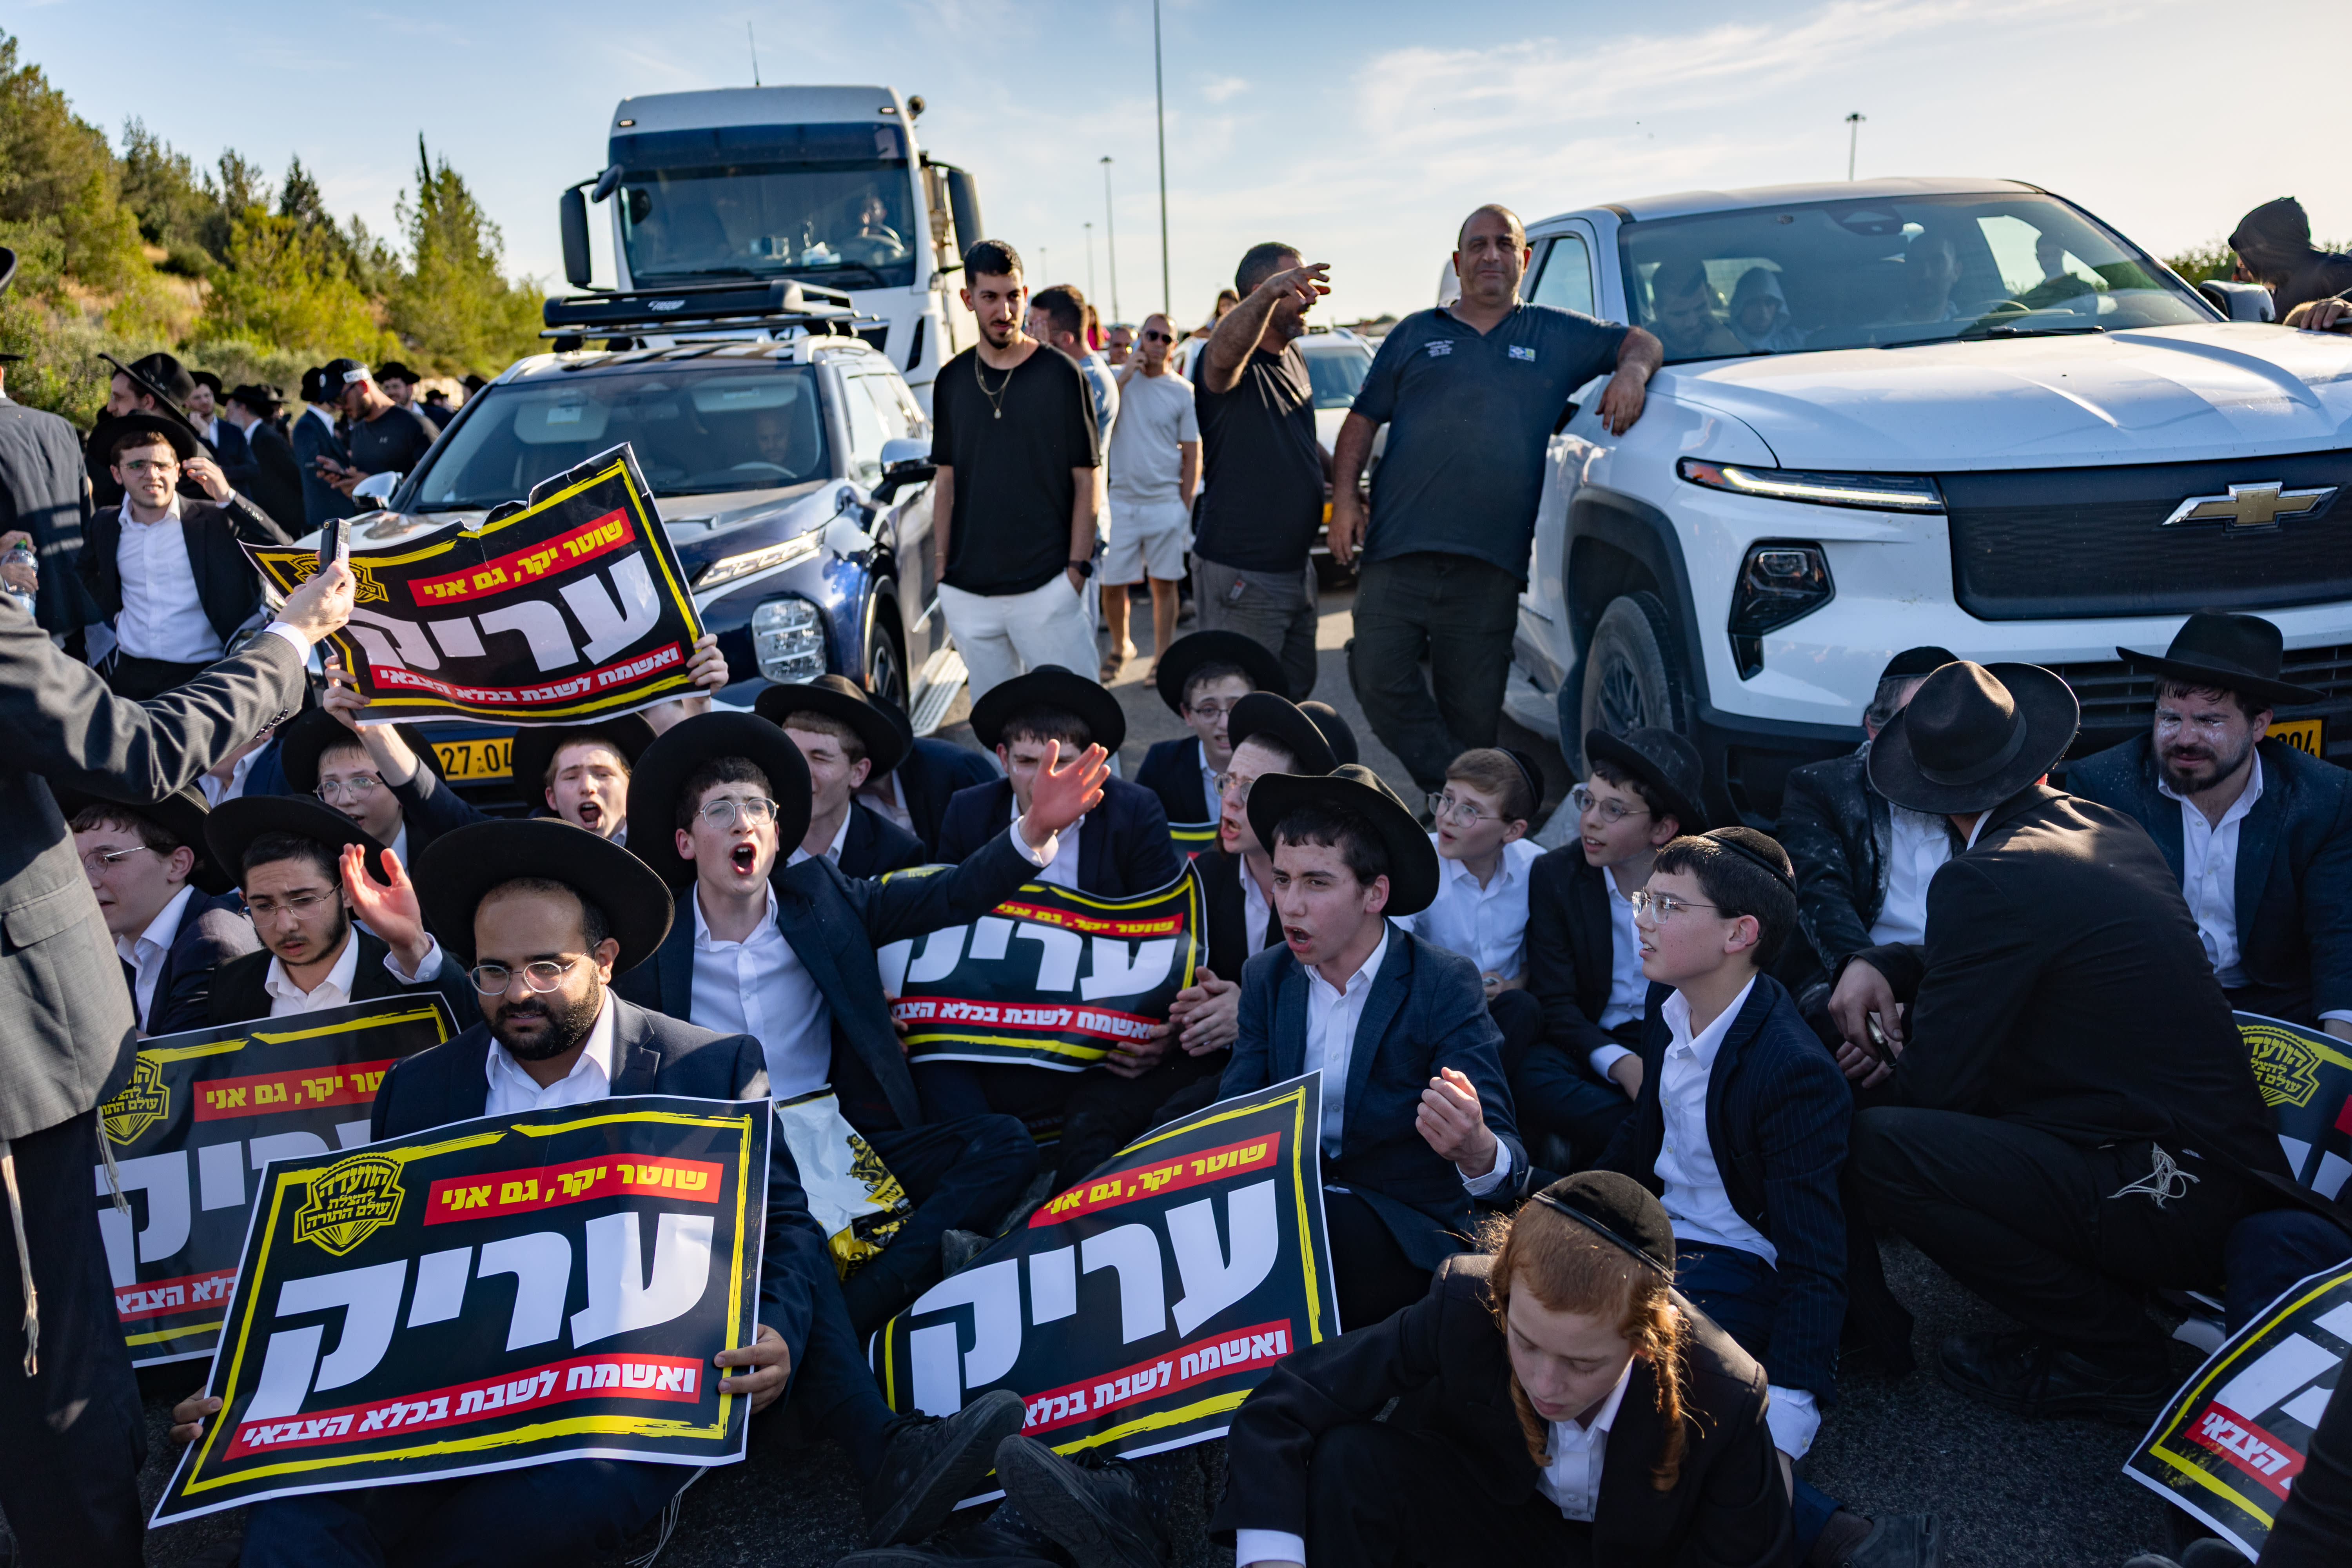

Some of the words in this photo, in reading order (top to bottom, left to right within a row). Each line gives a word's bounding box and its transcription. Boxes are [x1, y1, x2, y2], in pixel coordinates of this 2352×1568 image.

[563, 519, 623, 557] שוטר
[514, 547, 559, 583] יקר,
[423, 579, 468, 598] אני
[472, 567, 508, 590] גם
[346, 551, 661, 672] עריק
[597, 647, 679, 686] ואשמח
[380, 670, 451, 695] הצבאי
[455, 687, 517, 701] בכלא
[520, 677, 591, 702] לשבת
[997, 903, 1032, 916] אני
[1035, 910, 1063, 922] גם
[1116, 920, 1175, 933] שוטר
[940, 1002, 999, 1022] בכלא
[1002, 1008, 1073, 1025] לשבת
[2243, 1035, 2308, 1068] הוועד
[2250, 1057, 2287, 1075] להצל
[254, 1083, 287, 1105] גם
[295, 1076, 343, 1105] יקר,
[350, 1071, 385, 1093] טר
[2264, 1073, 2302, 1093] עולם
[128, 1097, 159, 1110] עולם
[207, 1087, 247, 1109] אני
[1191, 1143, 1267, 1176] שוטר
[319, 1164, 391, 1198] הוועדה
[545, 1166, 607, 1202] יקר,
[617, 1164, 708, 1191] שוטר
[1127, 1165, 1183, 1197] יקר,
[327, 1189, 376, 1210] להצלת
[441, 1184, 492, 1210] אני
[499, 1179, 539, 1205] גם
[1043, 1190, 1083, 1214] אני
[1089, 1180, 1122, 1203] גם
[307, 1207, 353, 1229] התורה
[356, 1201, 391, 1217] עולם
[115, 1285, 185, 1314] הצבא
[910, 1179, 1279, 1417] עריק
[241, 1212, 715, 1423] עריק
[1180, 1330, 1287, 1381] ואשמח
[566, 1363, 696, 1393] ואשמח
[1093, 1360, 1173, 1409] לשבת
[455, 1369, 560, 1416] לשבת
[358, 1396, 450, 1433] בכלא
[1022, 1390, 1087, 1428] בכלא
[242, 1414, 355, 1447] הצבאי
[2201, 1412, 2291, 1476] הצבאי
